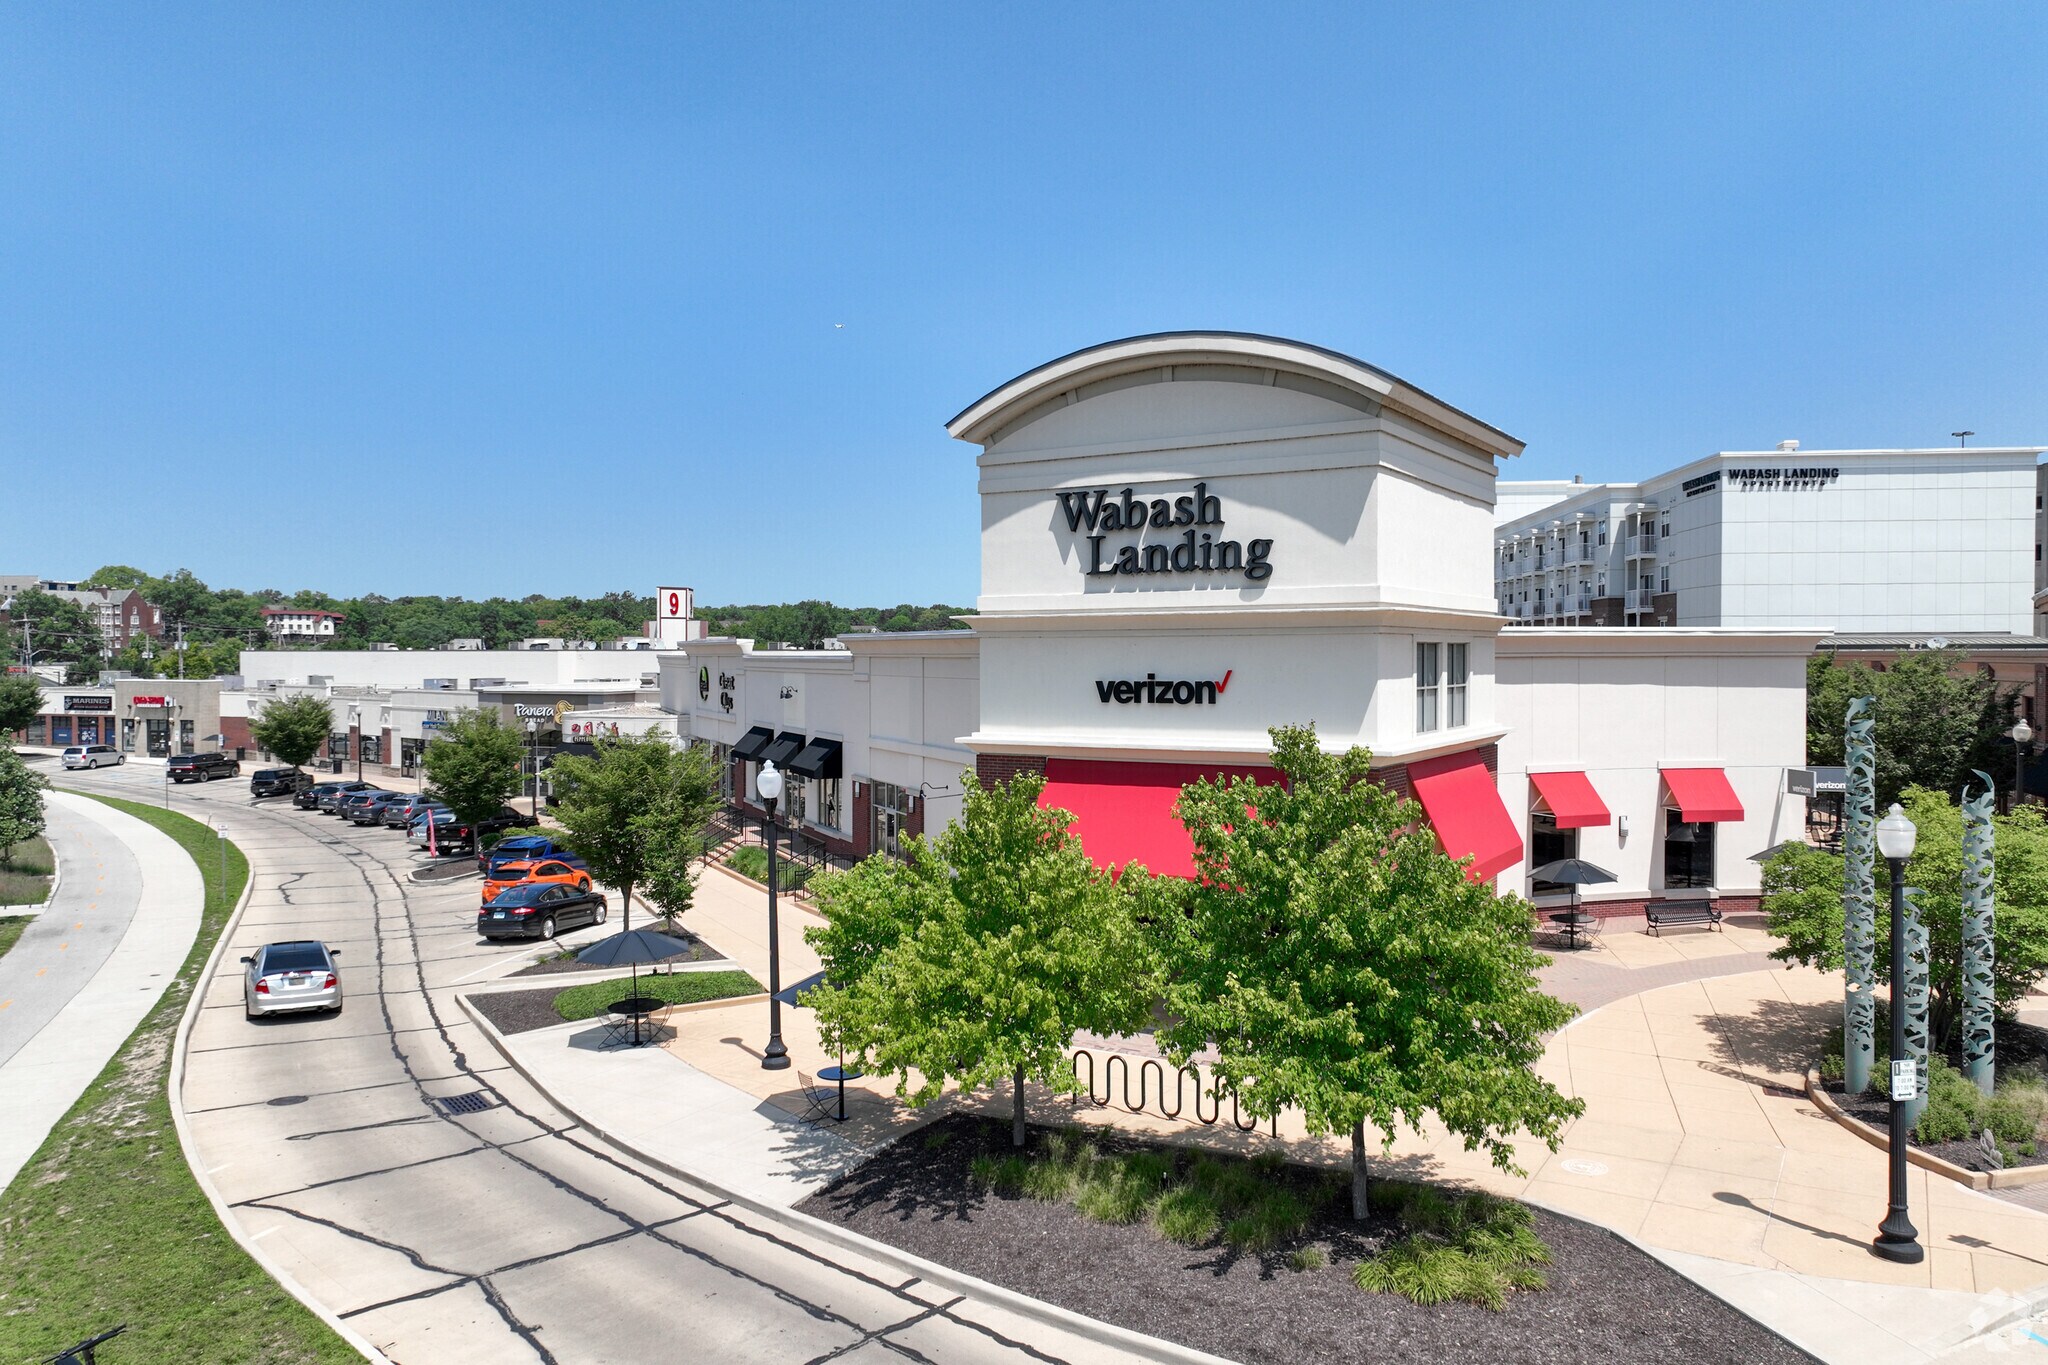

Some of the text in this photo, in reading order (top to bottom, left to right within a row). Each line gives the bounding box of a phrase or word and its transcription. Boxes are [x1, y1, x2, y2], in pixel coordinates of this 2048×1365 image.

[1728, 468, 1839, 479] WABASH LANDING
[1055, 482, 1225, 532] Wabash
[1086, 529, 1274, 580] Landing
[669, 592, 679, 616] 9
[1095, 672, 1217, 704] verizon
[514, 703, 554, 717] Panera
[1791, 785, 1811, 794] verizon
[1816, 781, 1846, 789] verizon
